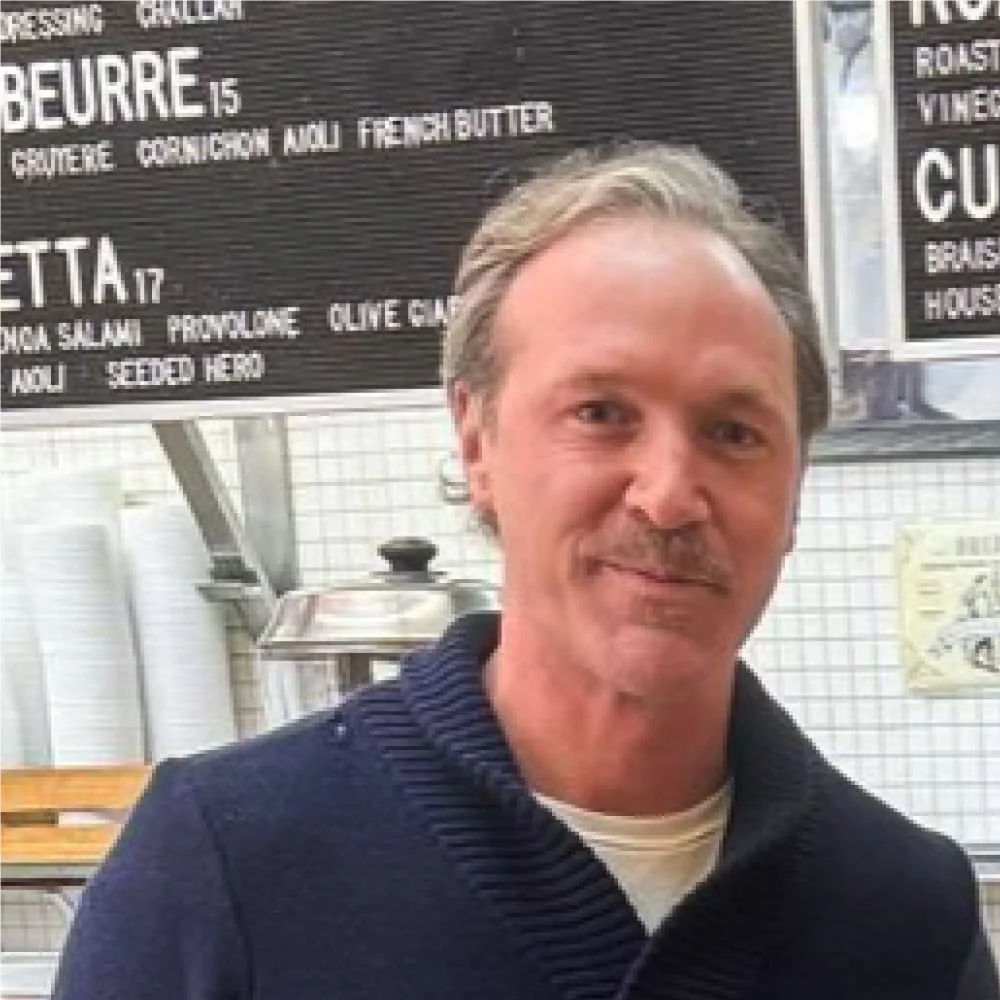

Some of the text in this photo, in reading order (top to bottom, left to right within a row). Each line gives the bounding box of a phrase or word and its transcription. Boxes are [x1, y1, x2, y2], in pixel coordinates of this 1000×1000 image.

[0, 47, 242, 132] BEURRE 15
[136, 128, 271, 168] CORNICHON
[283, 120, 341, 156] AIOLI
[357, 113, 449, 150] FRENCH
[454, 101, 553, 141] BUTTER
[0, 235, 165, 311] ETTA 17
[57, 318, 143, 351] SALAMI
[166, 307, 303, 343] PROVOLONE
[327, 299, 402, 332] OLIVE
[11, 350, 265, 396] AIOLI SEEDED HERO
